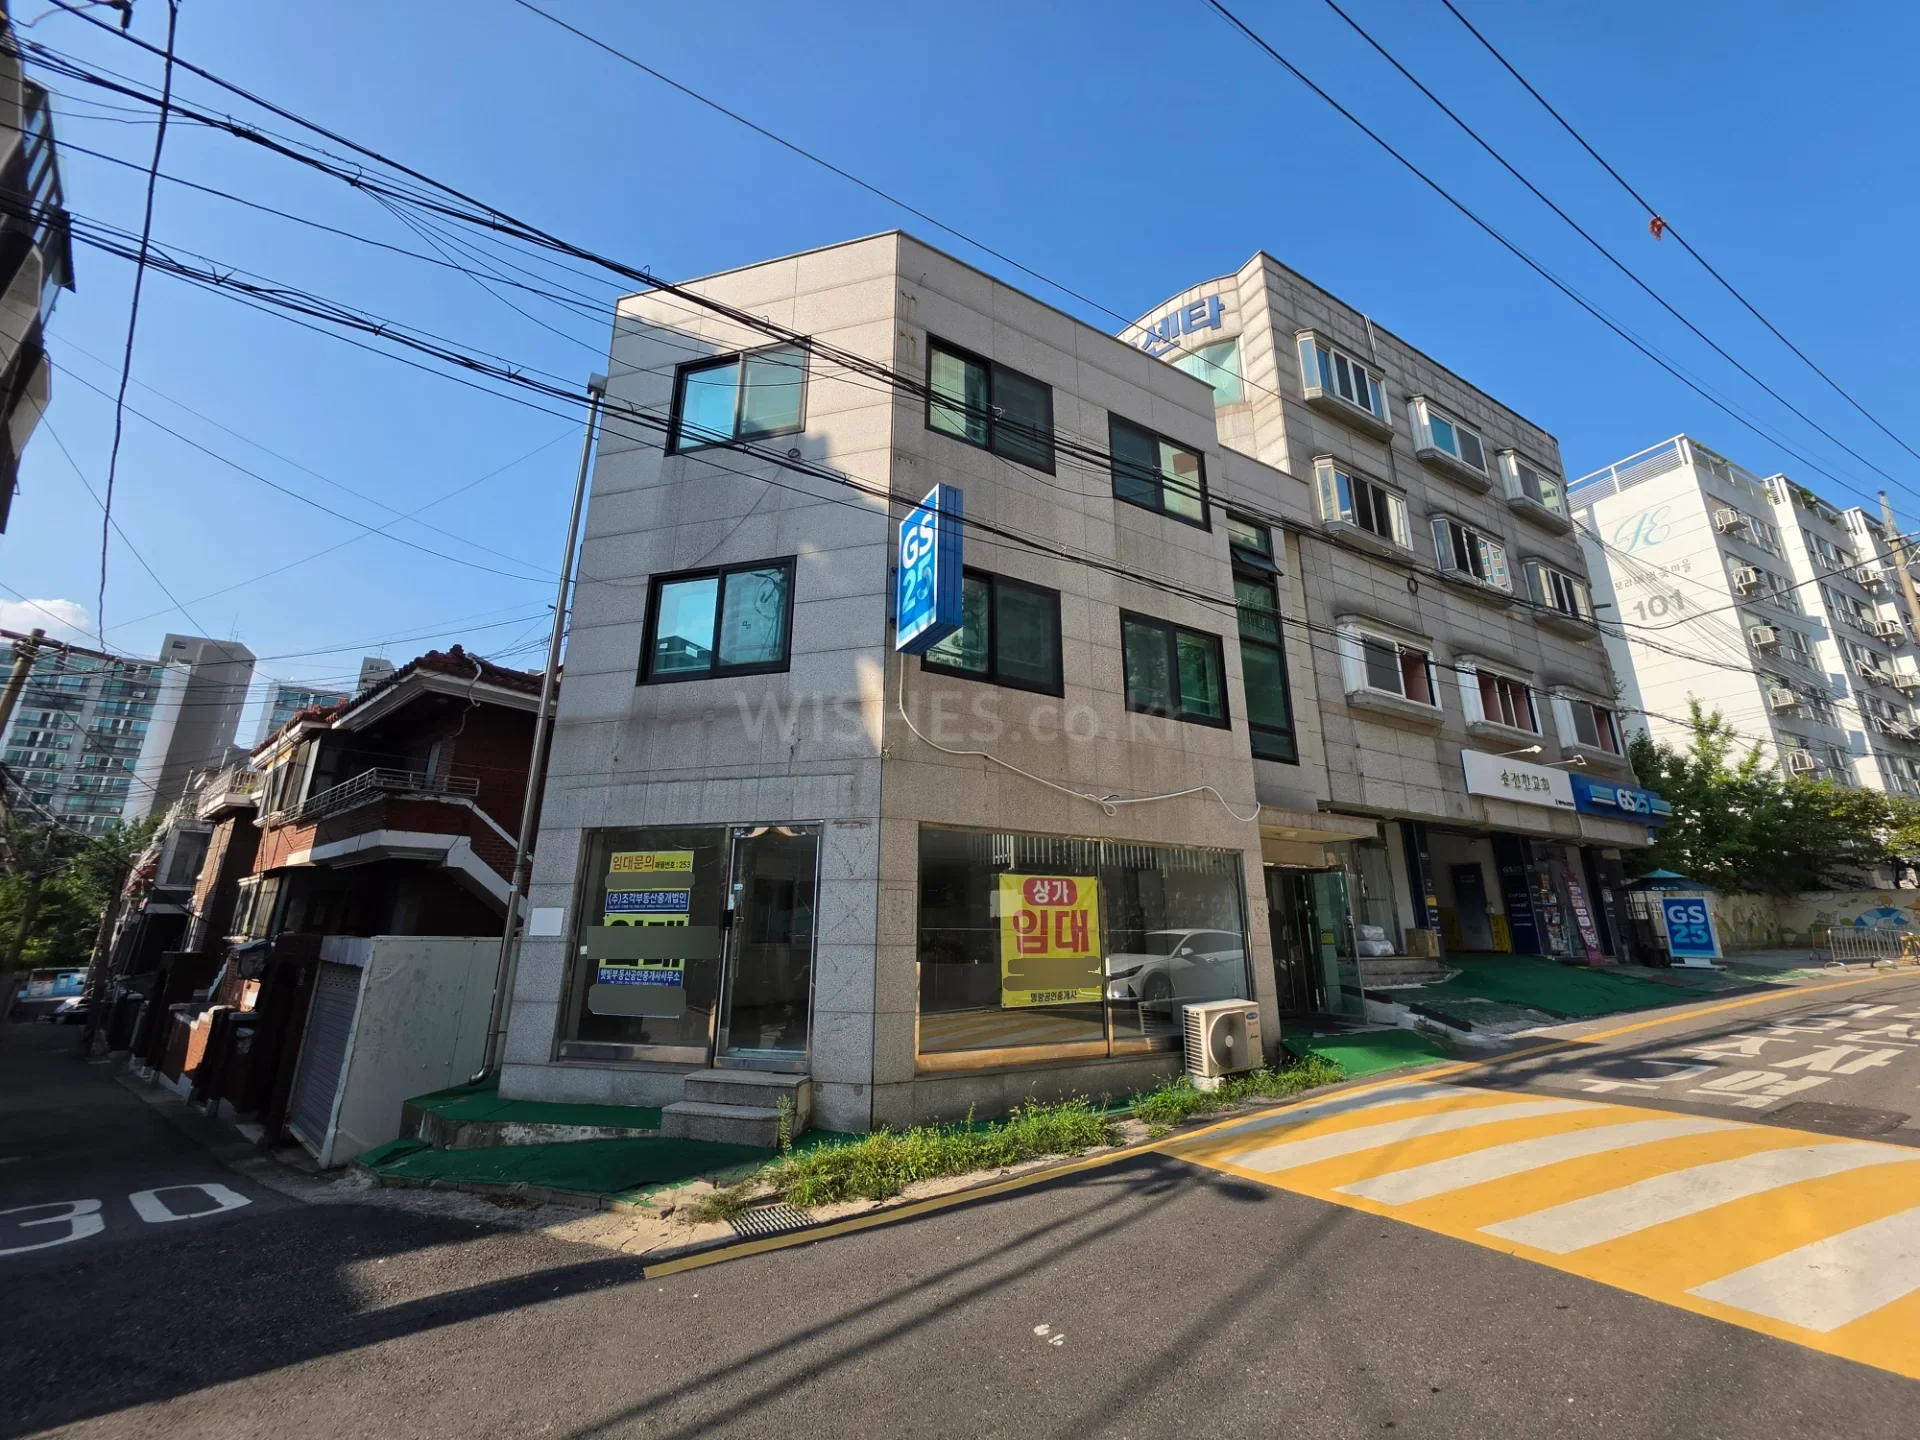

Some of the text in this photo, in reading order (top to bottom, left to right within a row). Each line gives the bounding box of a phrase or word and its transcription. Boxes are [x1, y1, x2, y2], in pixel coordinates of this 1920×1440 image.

[902, 511, 934, 569] GS
[902, 551, 933, 615] 25
[1633, 589, 1685, 621] 101
[1617, 788, 1650, 814] GS25
[613, 855, 655, 870] 임대문의
[1032, 880, 1069, 903] 상가
[1012, 909, 1090, 954] 임대
[1667, 905, 1705, 924] GS
[1672, 924, 1709, 944] 25
[1682, 1034, 1905, 1075] 주차
[1578, 1060, 1832, 1109] 구역
[0, 1183, 253, 1256] 30
